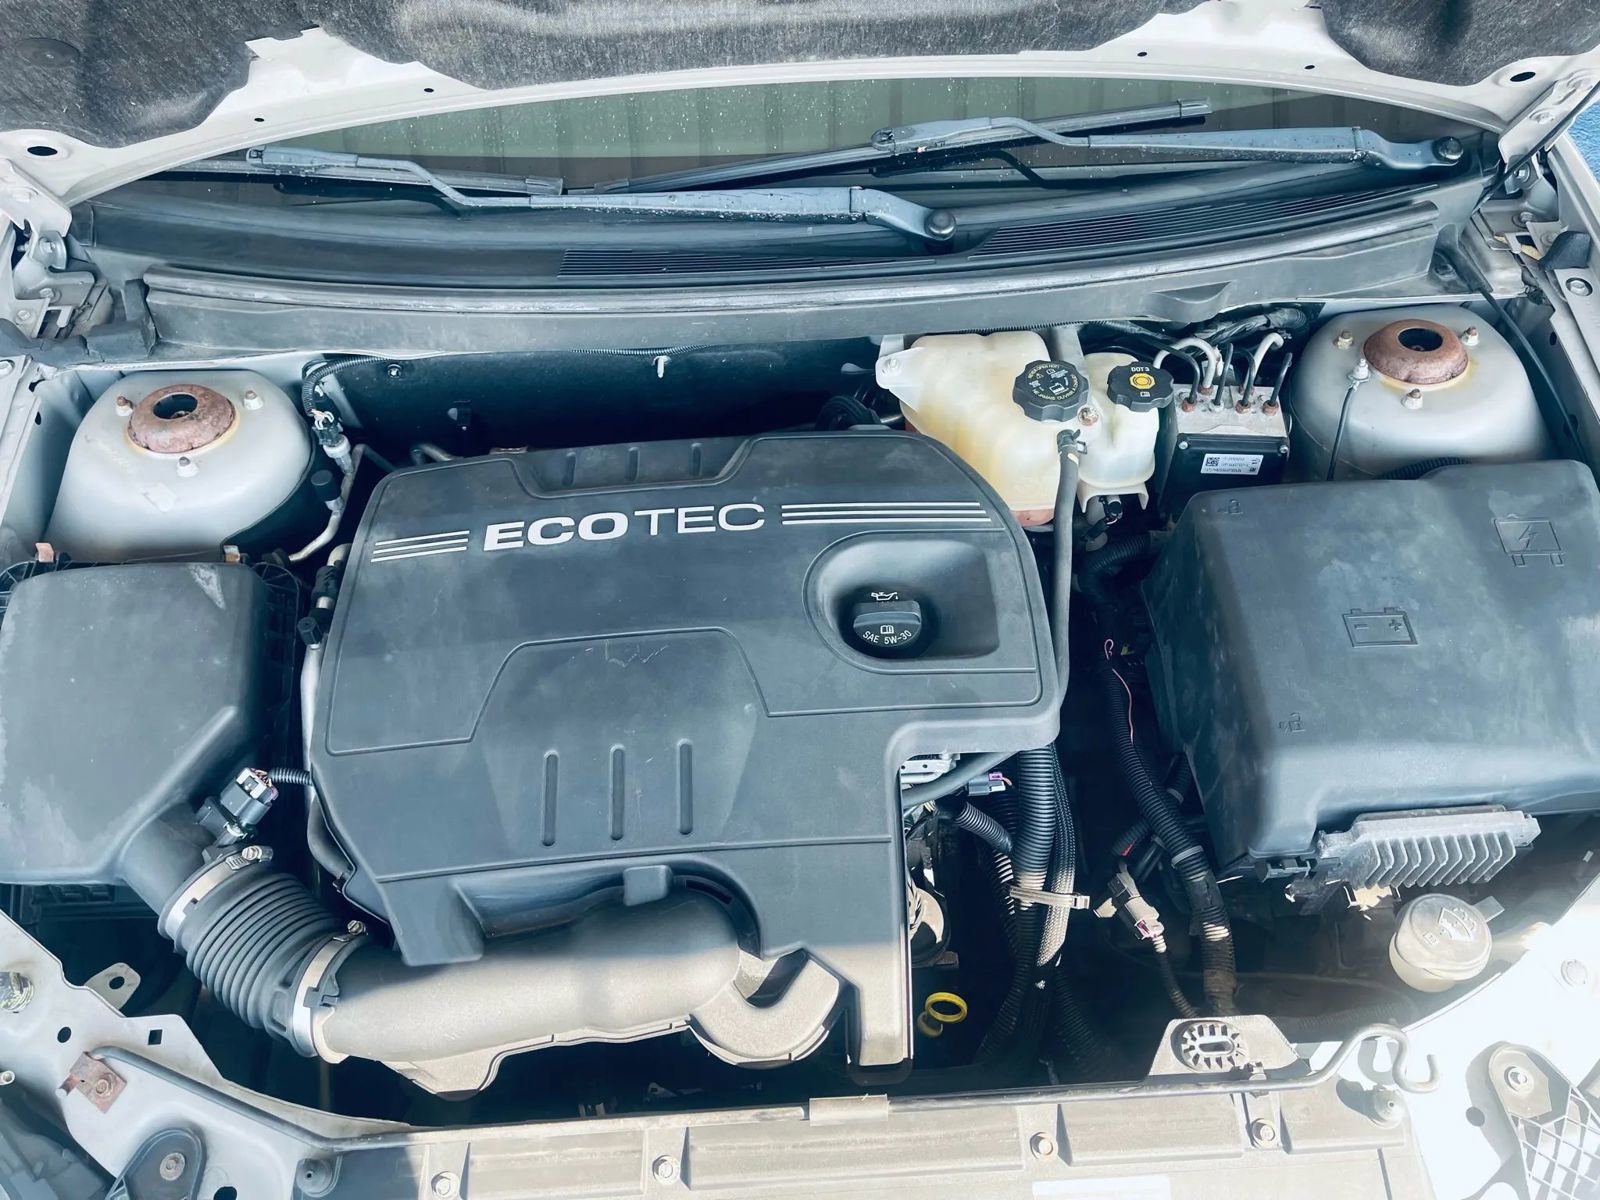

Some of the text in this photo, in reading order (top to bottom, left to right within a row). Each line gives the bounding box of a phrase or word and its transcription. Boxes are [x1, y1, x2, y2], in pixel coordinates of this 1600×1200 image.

[483, 503, 765, 551] ECOTEC
[863, 630, 912, 645] SAE 5W-30
